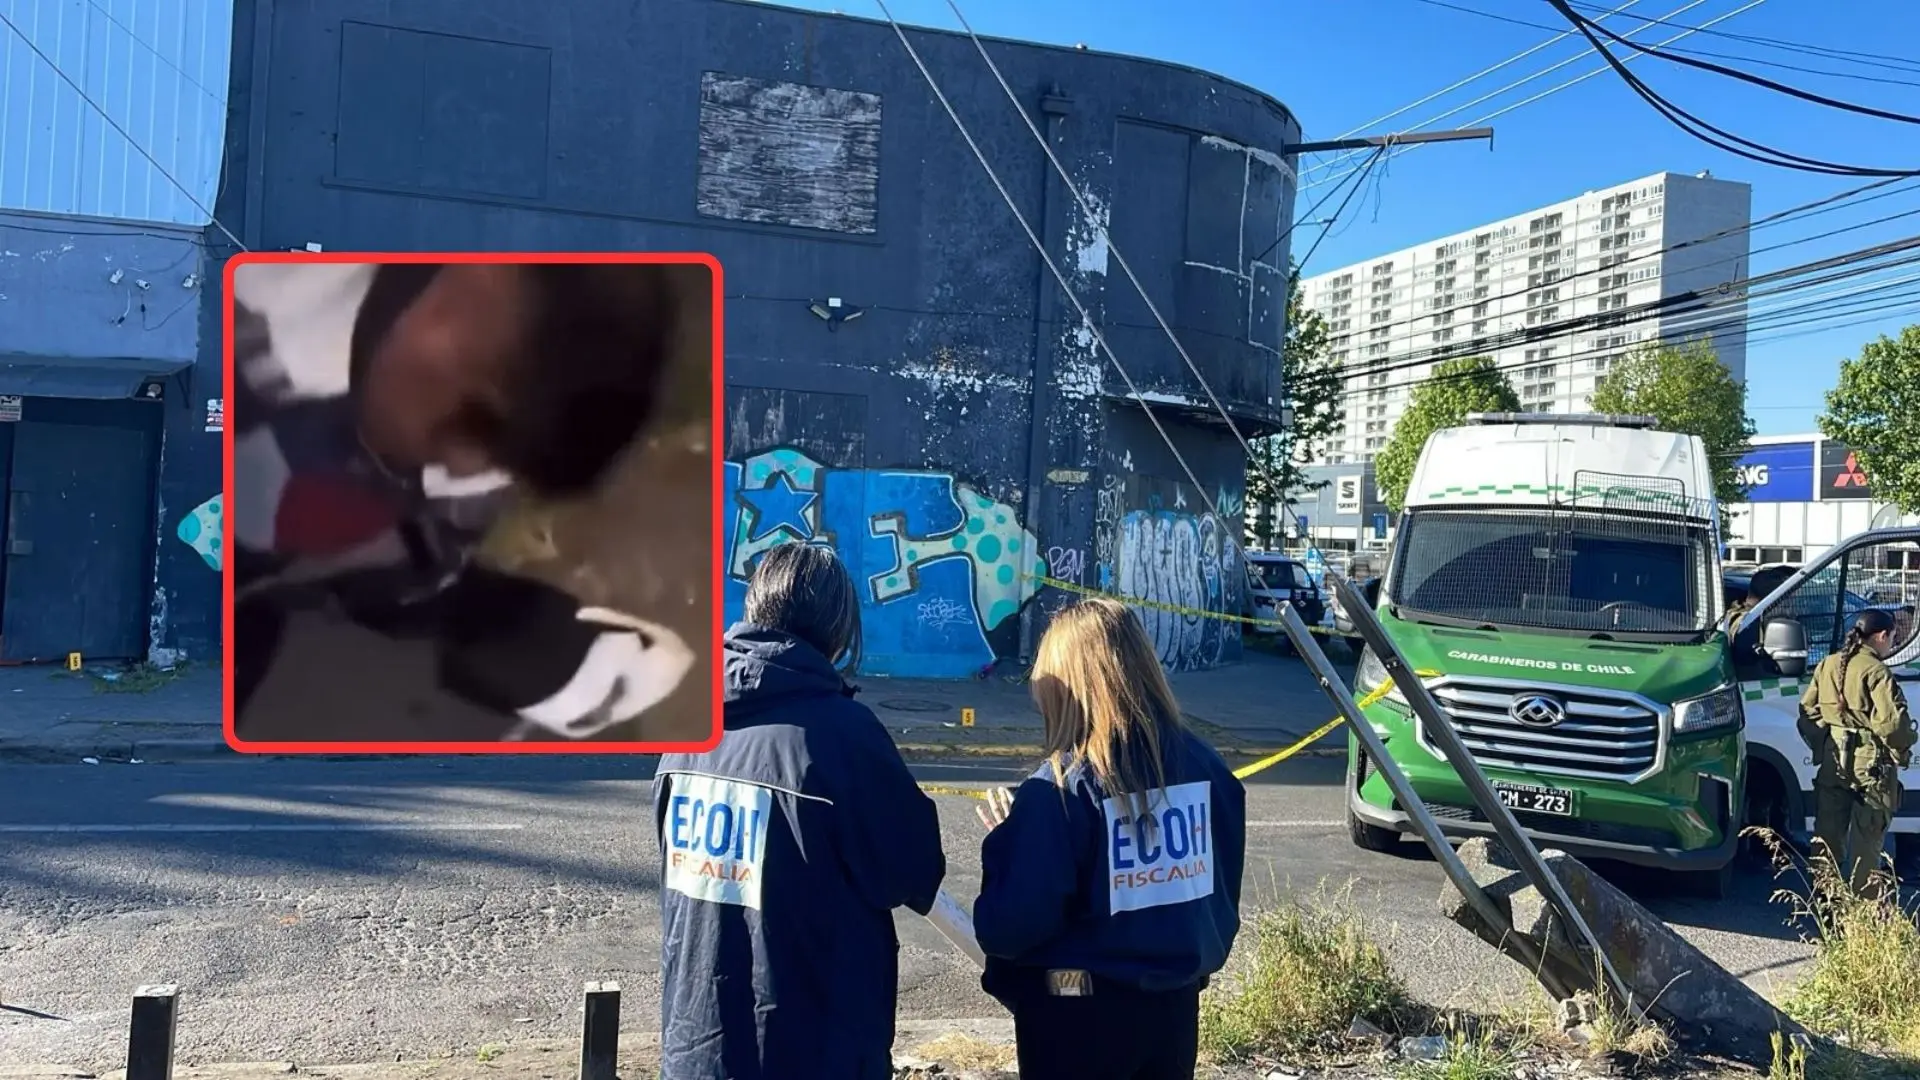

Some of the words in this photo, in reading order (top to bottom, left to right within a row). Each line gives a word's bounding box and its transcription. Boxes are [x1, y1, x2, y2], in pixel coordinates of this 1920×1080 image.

[1448, 650, 1557, 670] CARABINEROS
[1561, 662, 1582, 672] DE
[1586, 664, 1636, 674] CHILE
[1533, 794, 1566, 812] 273
[671, 796, 760, 864] ECOH
[1113, 802, 1206, 870] ECOH
[1113, 859, 1206, 890] FISCALIA
